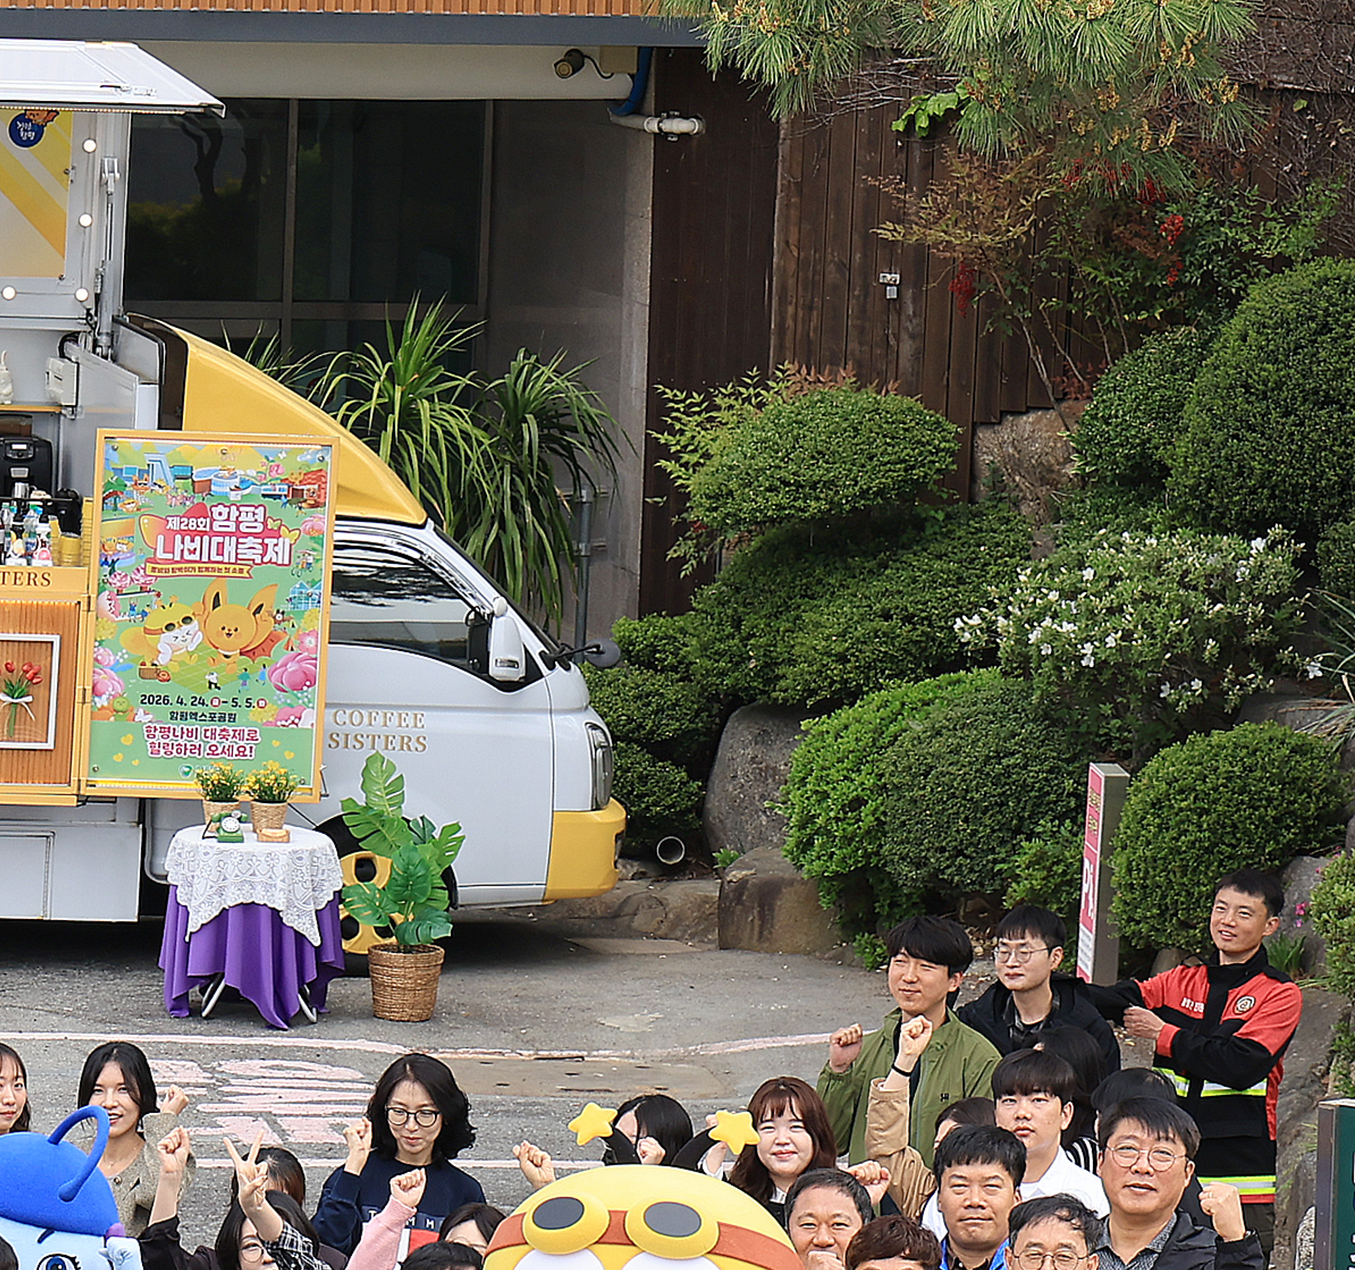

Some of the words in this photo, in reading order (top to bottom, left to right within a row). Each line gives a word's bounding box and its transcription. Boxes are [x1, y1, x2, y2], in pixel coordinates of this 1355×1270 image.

[166, 516, 210, 532] 제28회
[211, 504, 265, 533] 함평
[156, 534, 291, 565] 나비대축제
[140, 694, 173, 706] 2026.
[177, 695, 187, 707] 4.
[332, 708, 425, 729] COFFEE
[145, 725, 199, 737] 함평나비
[203, 727, 260, 742] 대축제로
[328, 731, 427, 753] SISTERS
[149, 741, 202, 756] 힐링하러
[206, 744, 255, 758] 오세요!
